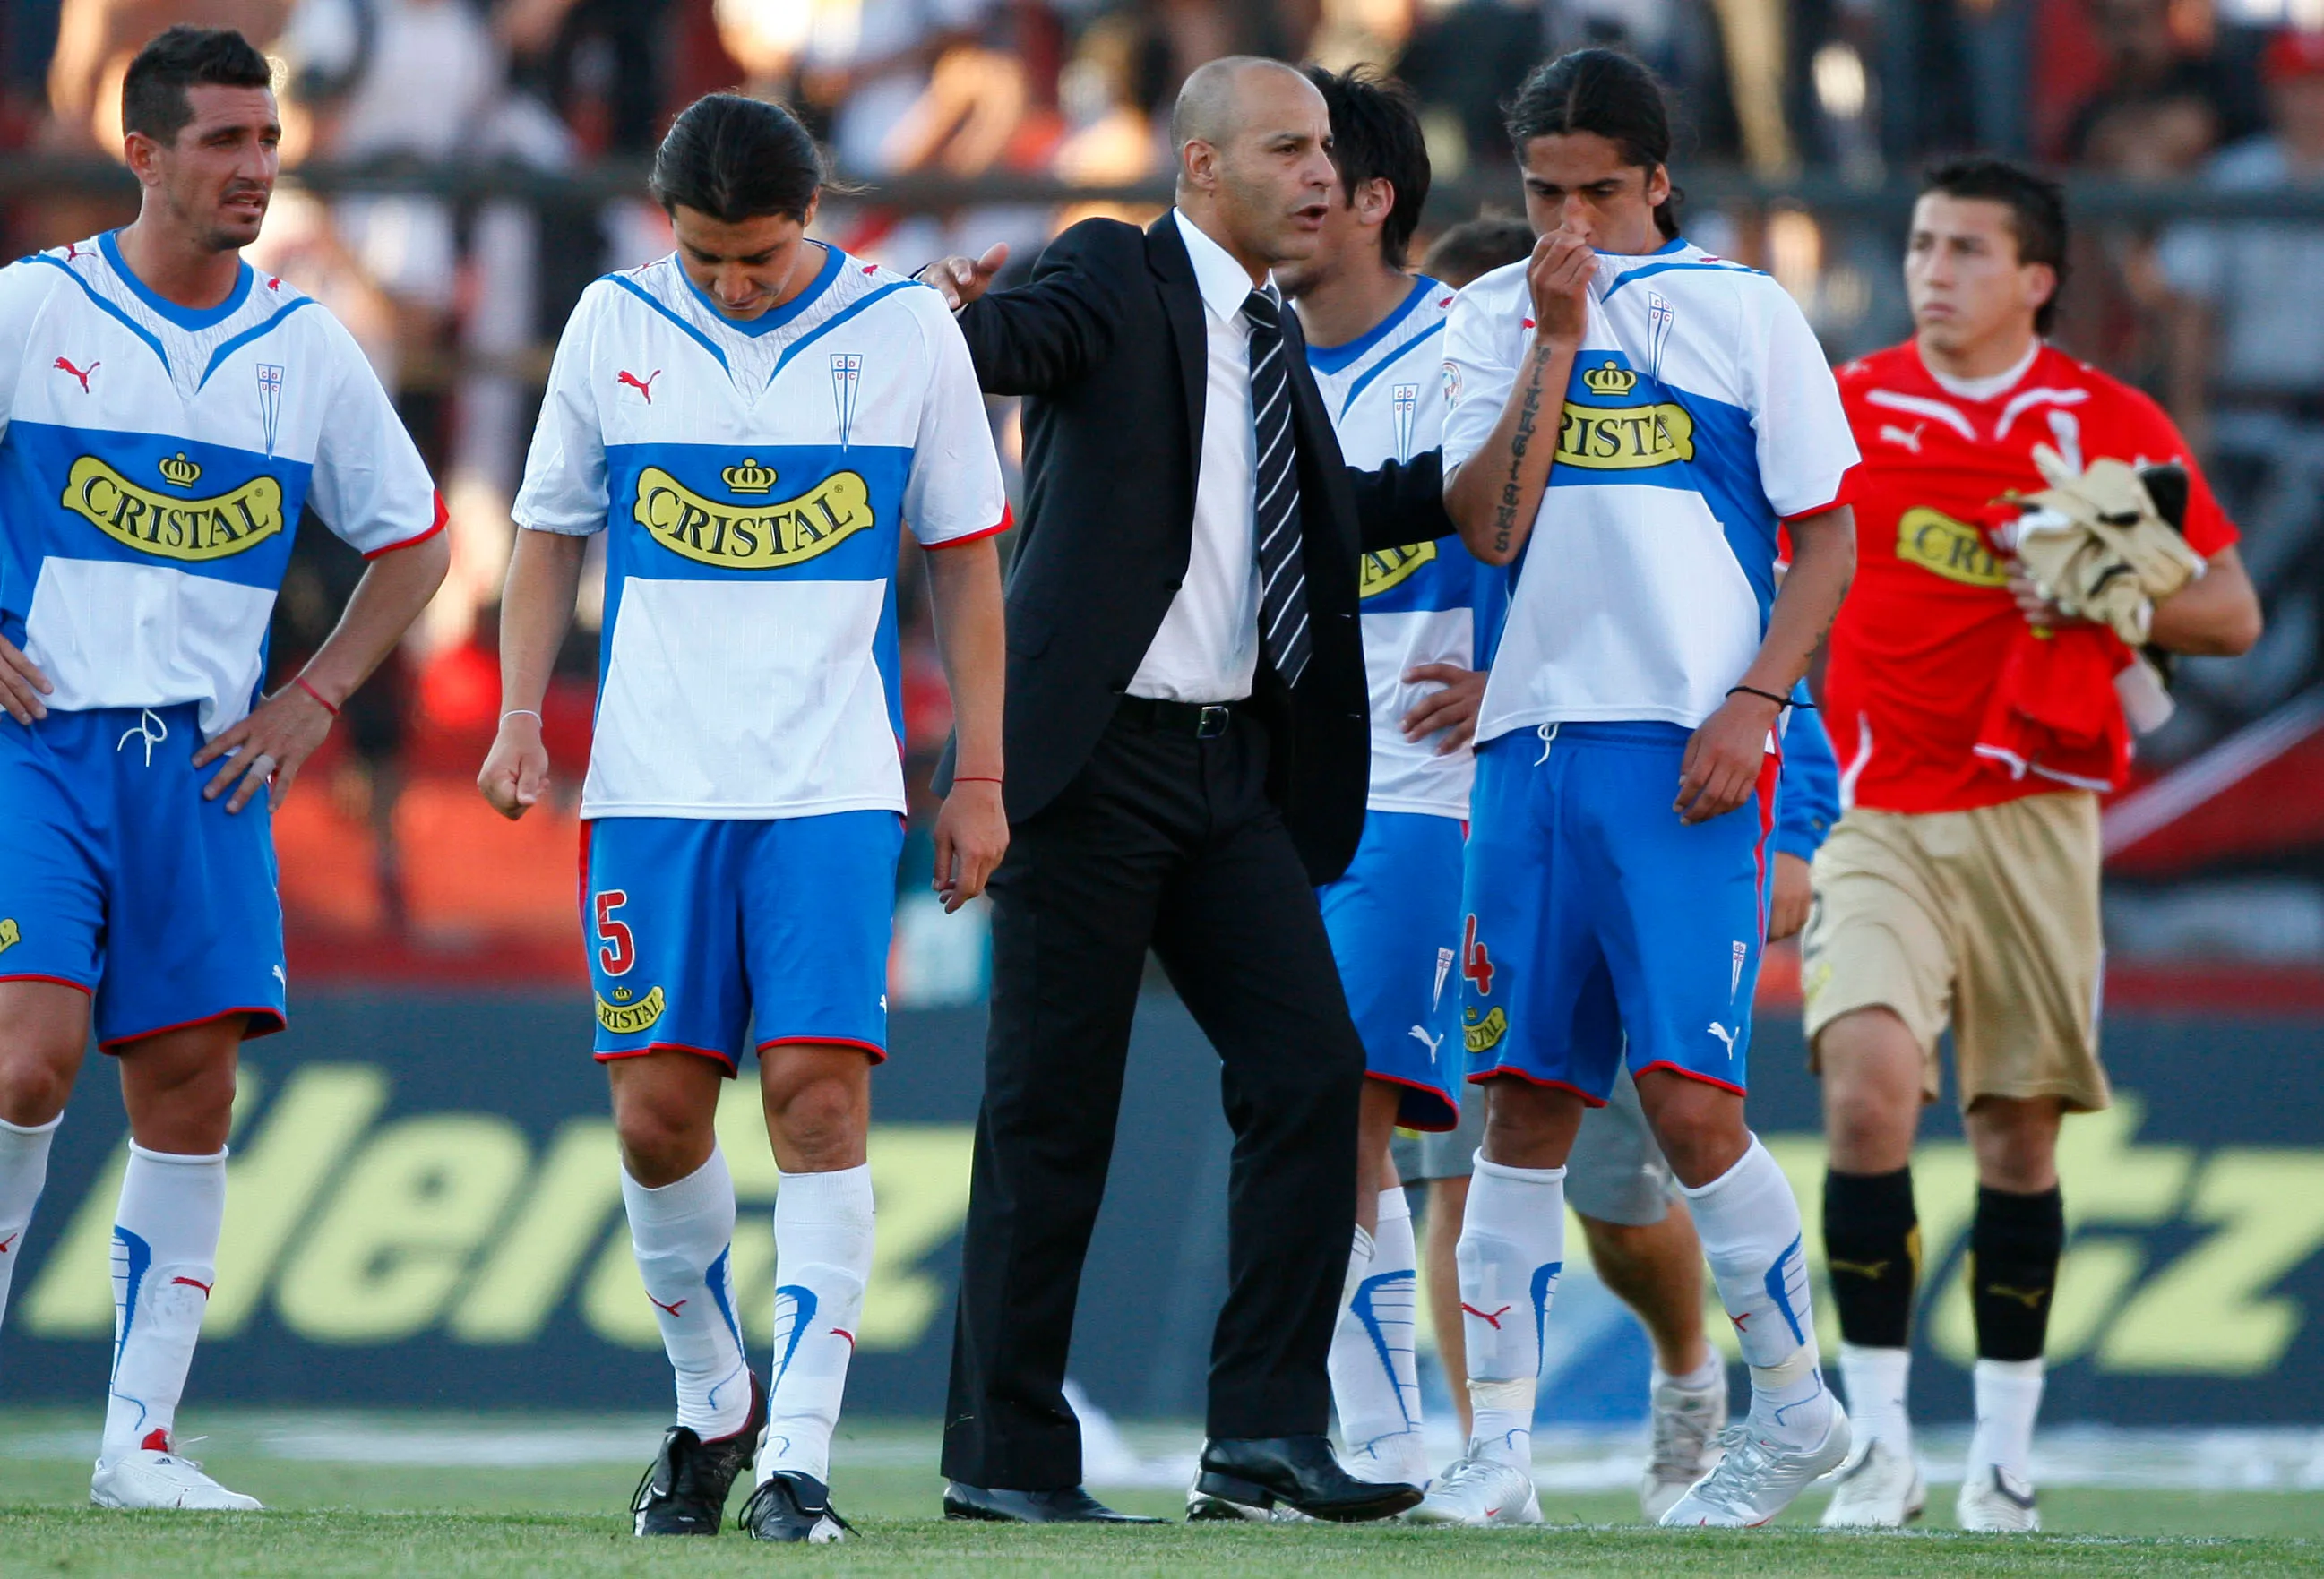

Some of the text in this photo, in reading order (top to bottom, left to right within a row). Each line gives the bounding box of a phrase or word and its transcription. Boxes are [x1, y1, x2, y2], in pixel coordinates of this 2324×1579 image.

[82, 476, 269, 549] CRISTAL
[647, 486, 854, 557] CRISTAL
[595, 889, 635, 977] 5
[1462, 913, 1495, 996] 4
